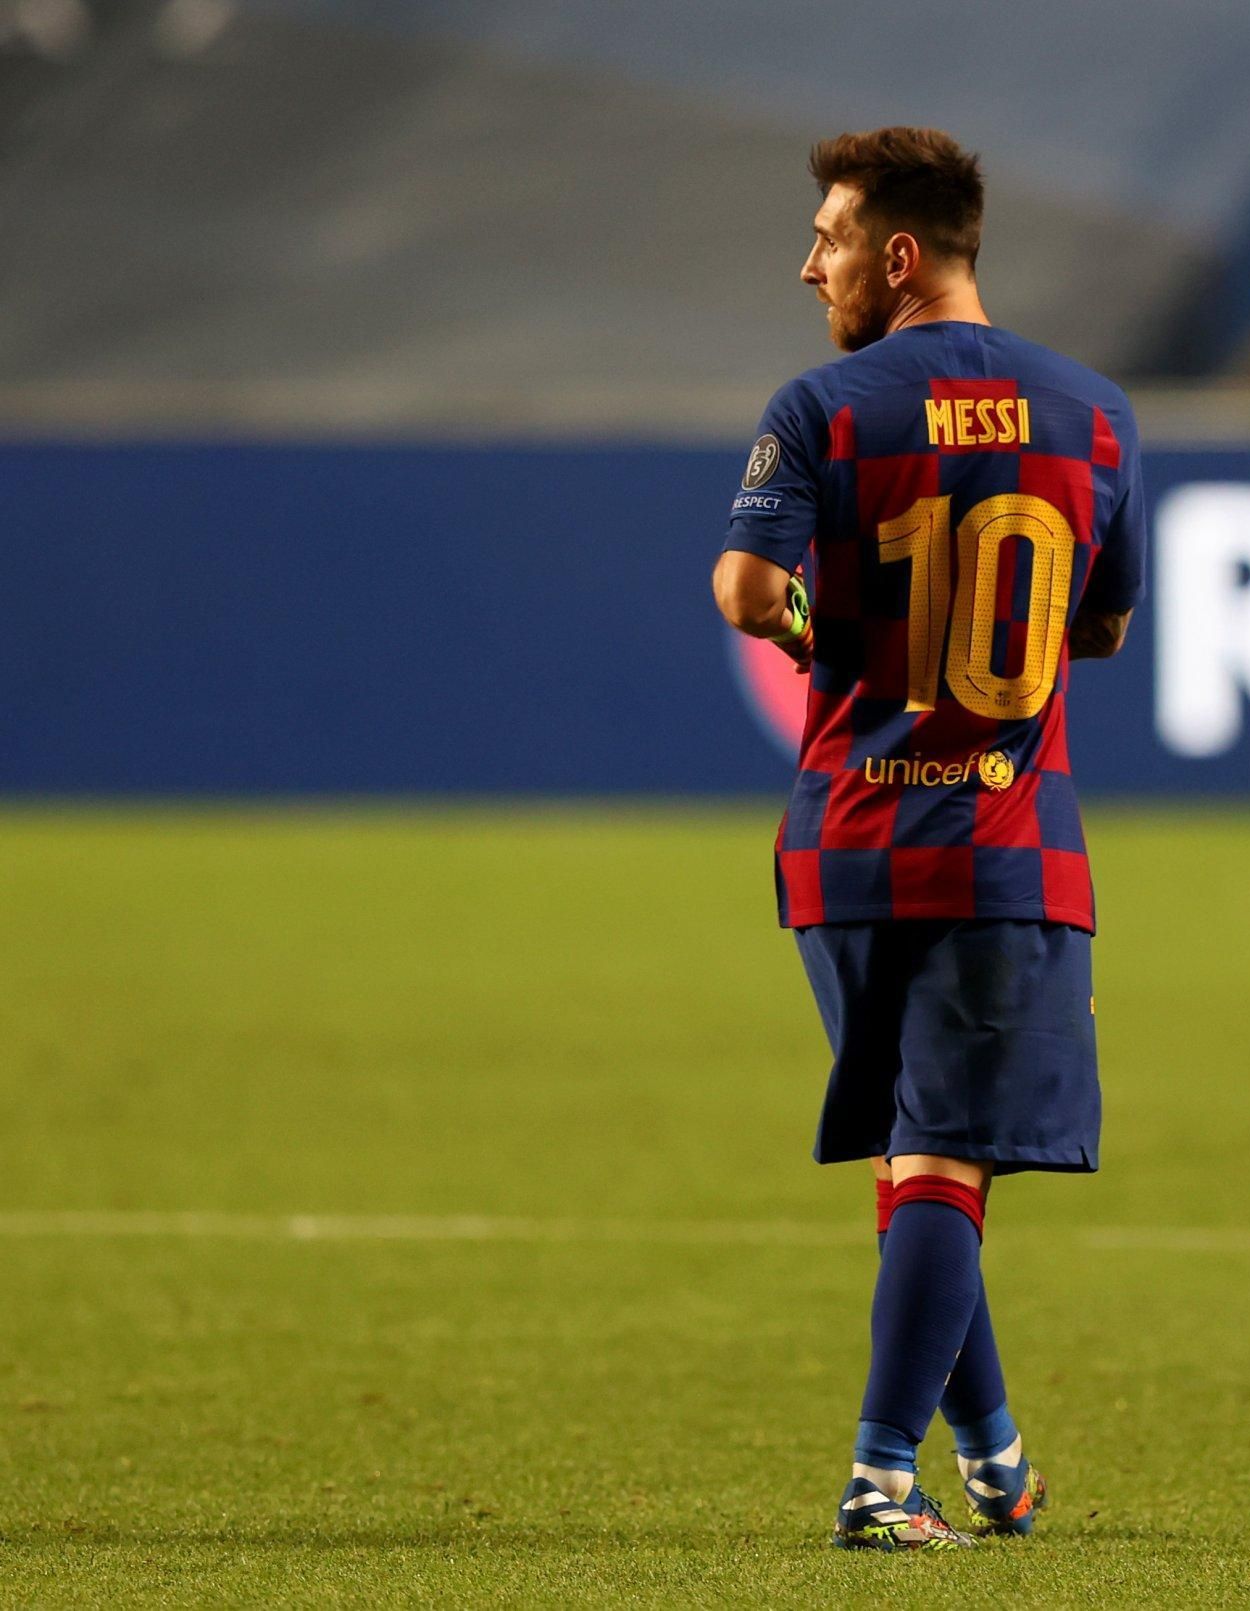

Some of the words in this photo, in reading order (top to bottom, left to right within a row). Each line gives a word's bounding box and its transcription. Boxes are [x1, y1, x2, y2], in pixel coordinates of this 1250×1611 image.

[925, 398, 1030, 445] MESSI
[751, 461, 762, 476] 5
[878, 493, 1075, 720] 10
[865, 751, 979, 787] unicef
